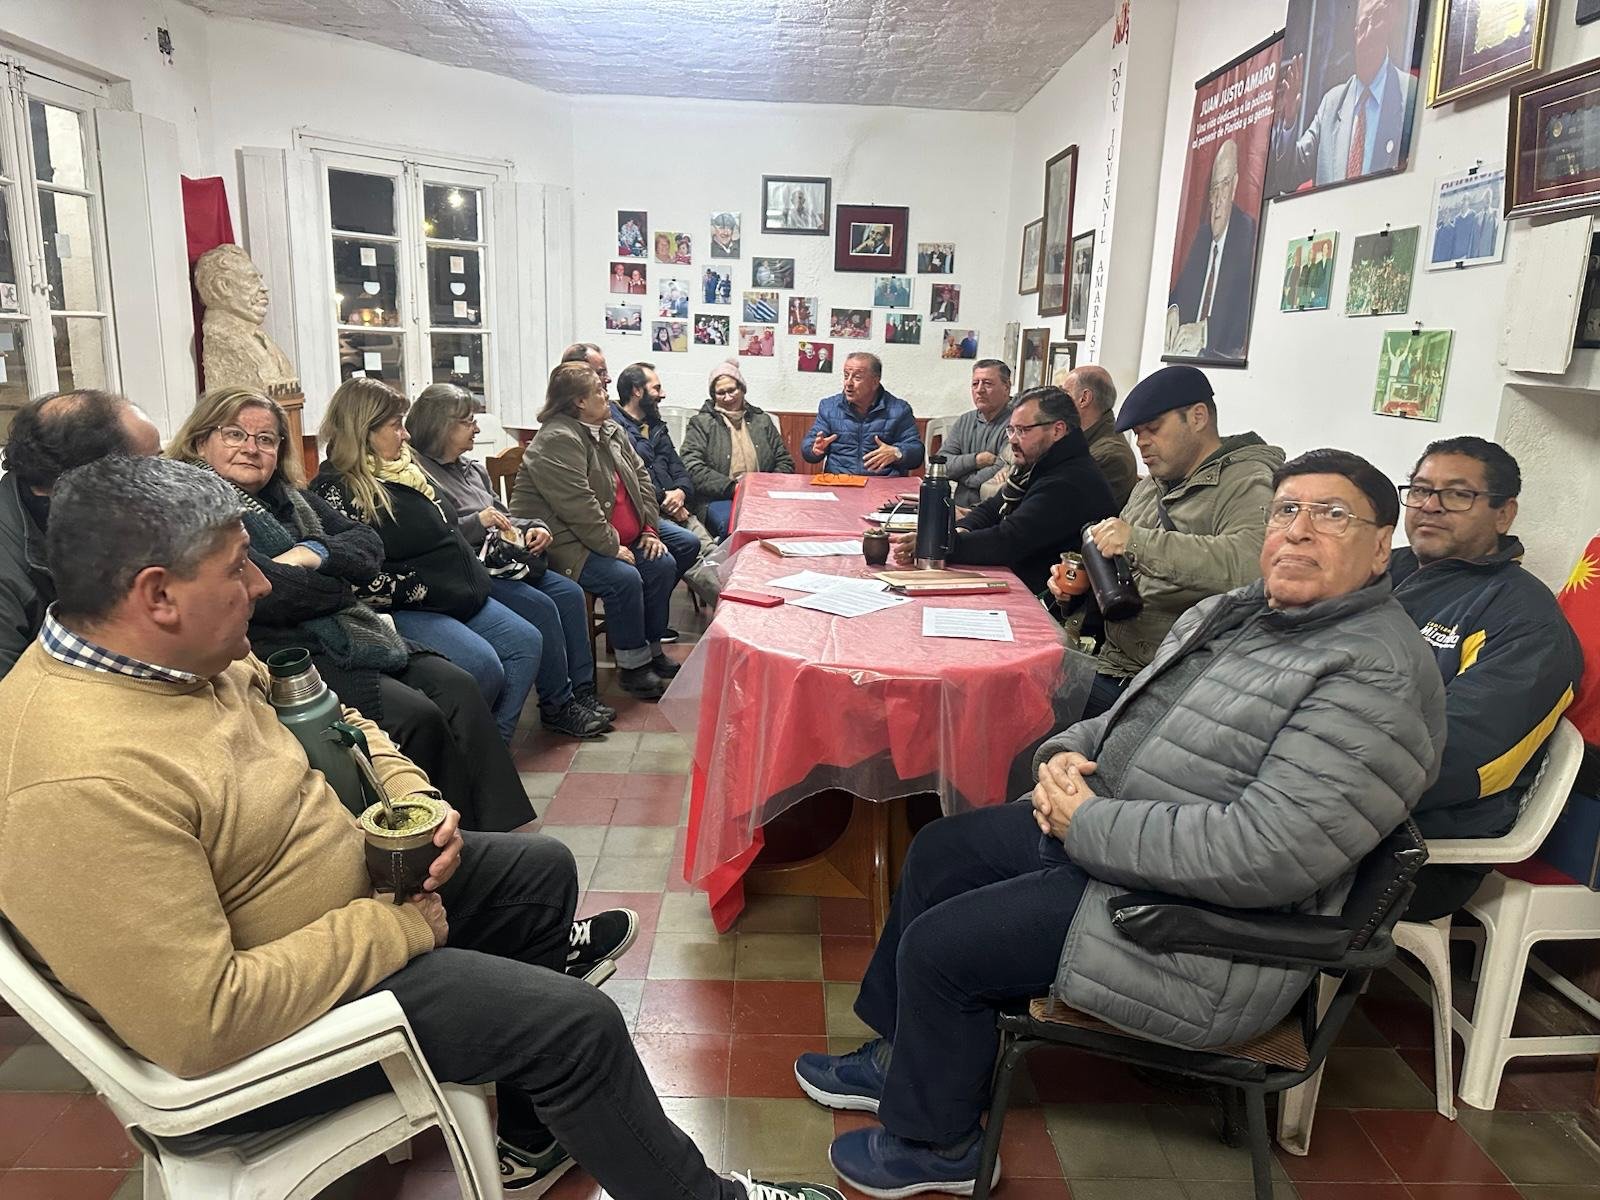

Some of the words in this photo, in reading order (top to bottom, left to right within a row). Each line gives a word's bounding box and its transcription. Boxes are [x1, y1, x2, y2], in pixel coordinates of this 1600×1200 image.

[1112, 61, 1122, 112] MOV.
[1200, 93, 1219, 117] JUAN
[1219, 80, 1244, 107] JUSTO
[1244, 62, 1276, 94] AMARO
[1196, 123, 1206, 134] Una
[1207, 117, 1216, 129] vida
[1217, 106, 1240, 125] dedicada
[1245, 99, 1251, 111] la
[1198, 128, 1216, 149] porvenir
[1217, 125, 1223, 137] de
[1224, 117, 1242, 135] Florida
[1247, 114, 1254, 125] su
[1100, 128, 1115, 244] JUVENIL
